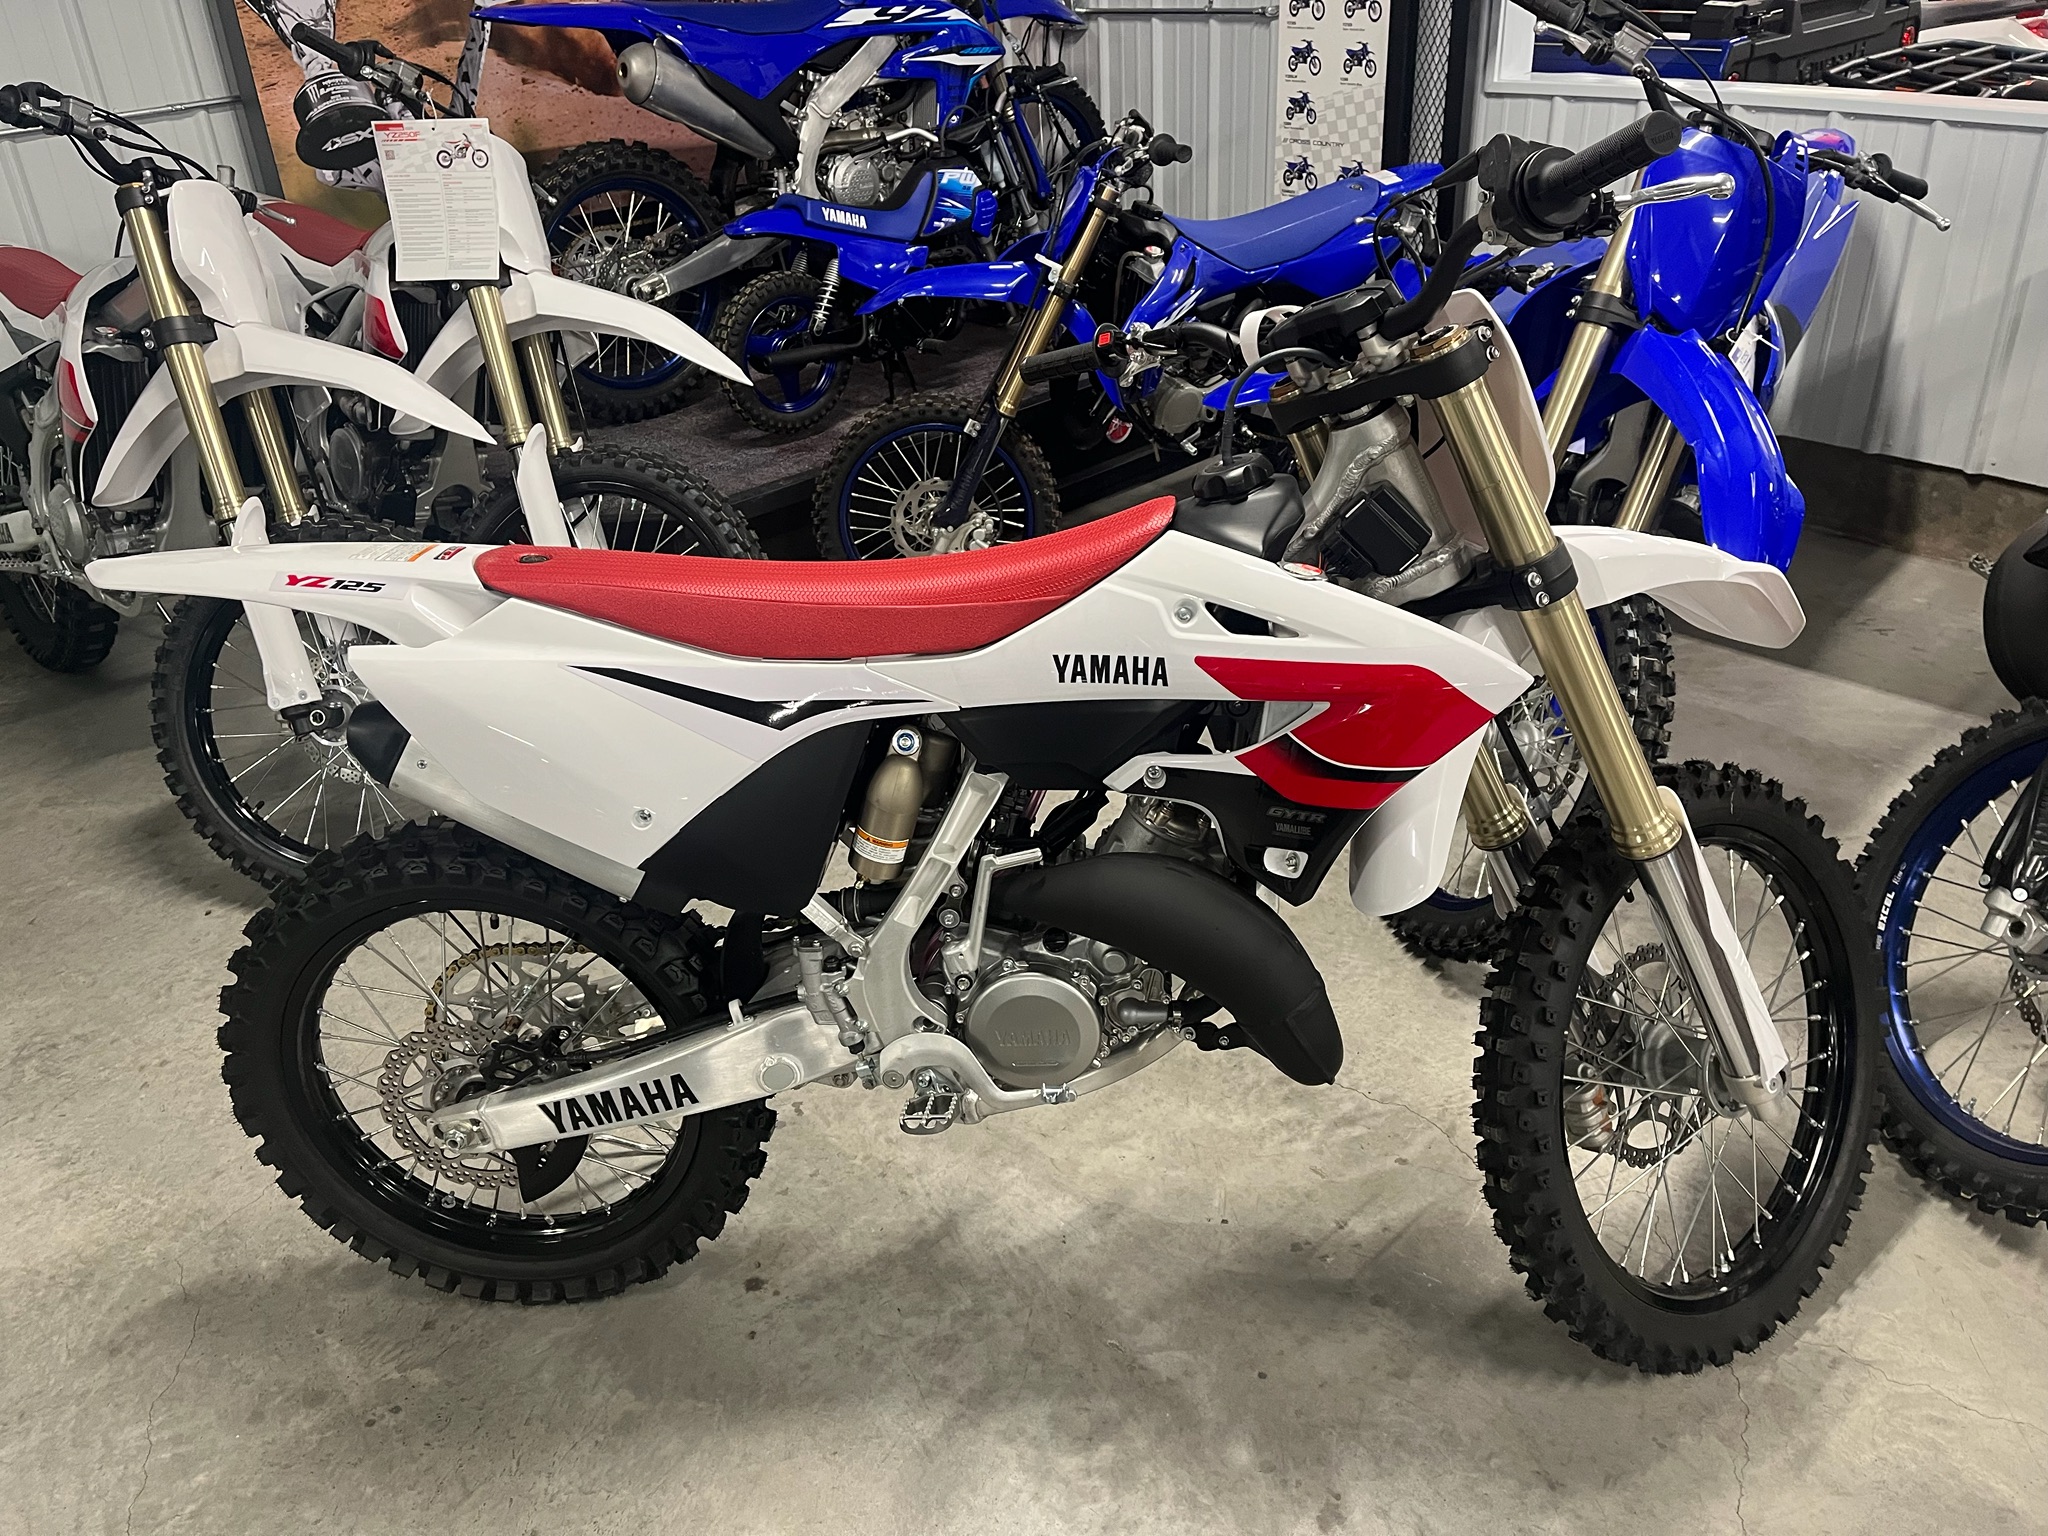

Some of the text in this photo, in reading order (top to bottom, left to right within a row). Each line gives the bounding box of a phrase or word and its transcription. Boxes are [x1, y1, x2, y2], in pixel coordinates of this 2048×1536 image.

[383, 131, 421, 139] YZ250F
[1289, 138, 1311, 146] CROSS
[821, 206, 867, 230] YAMAHA
[285, 574, 387, 593] YZ125
[1052, 654, 1169, 687] YAMAHA
[1266, 806, 1328, 823] GYTR
[1275, 822, 1312, 836] YAMALUBE
[1877, 891, 1896, 932] EXCEL
[995, 1029, 1072, 1047] YAMAHA
[537, 1073, 700, 1134] YAMAHA
